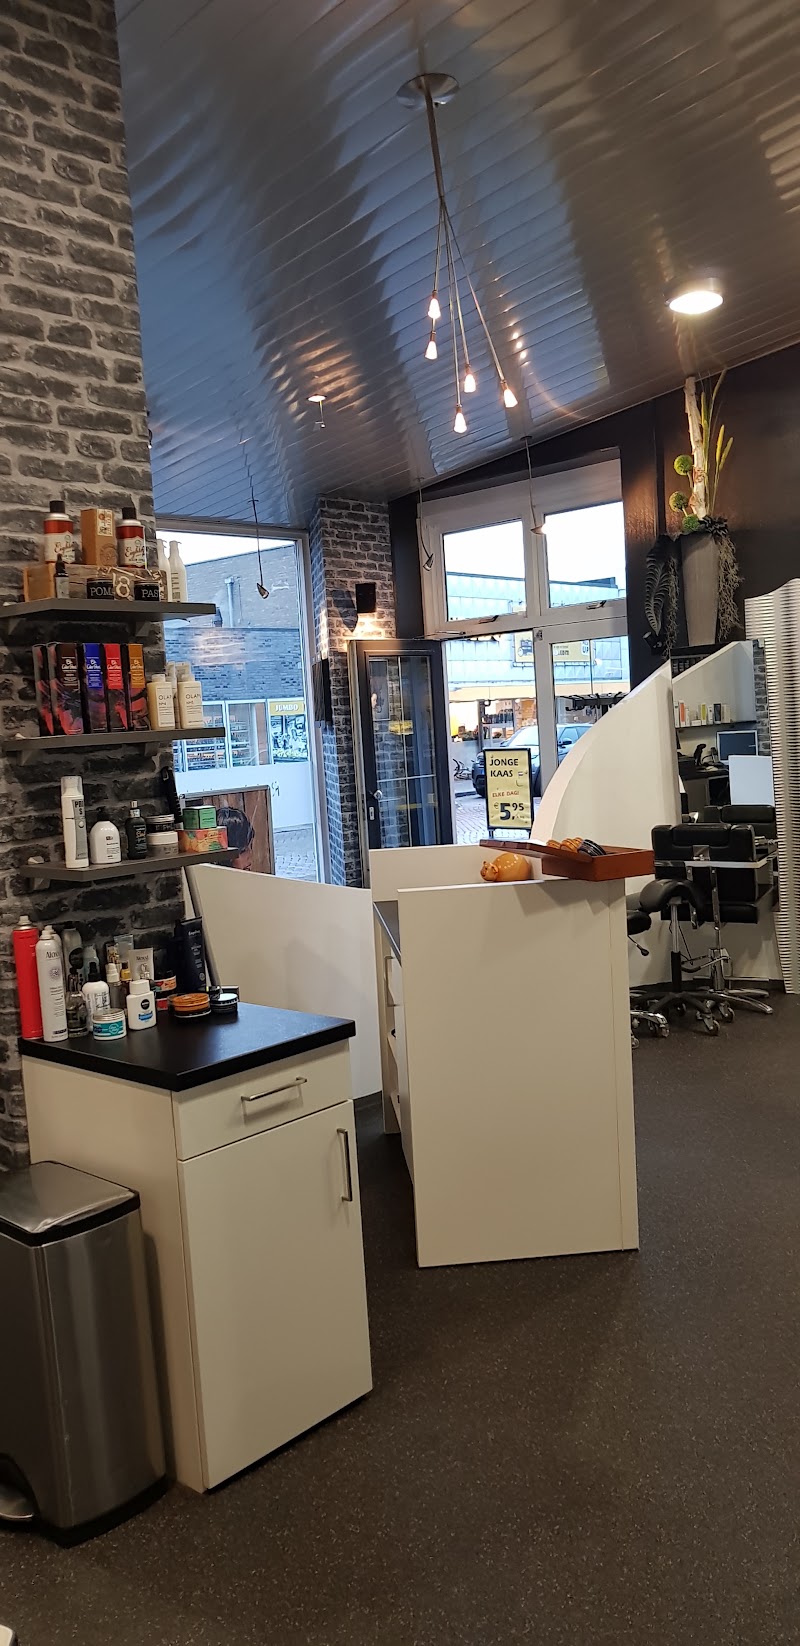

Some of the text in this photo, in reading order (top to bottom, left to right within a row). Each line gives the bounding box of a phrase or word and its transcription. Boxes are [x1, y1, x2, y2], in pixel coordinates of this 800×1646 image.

[275, 703, 299, 712] JUMBO
[489, 758, 519, 767] JONGE
[490, 769, 514, 778] KAAS
